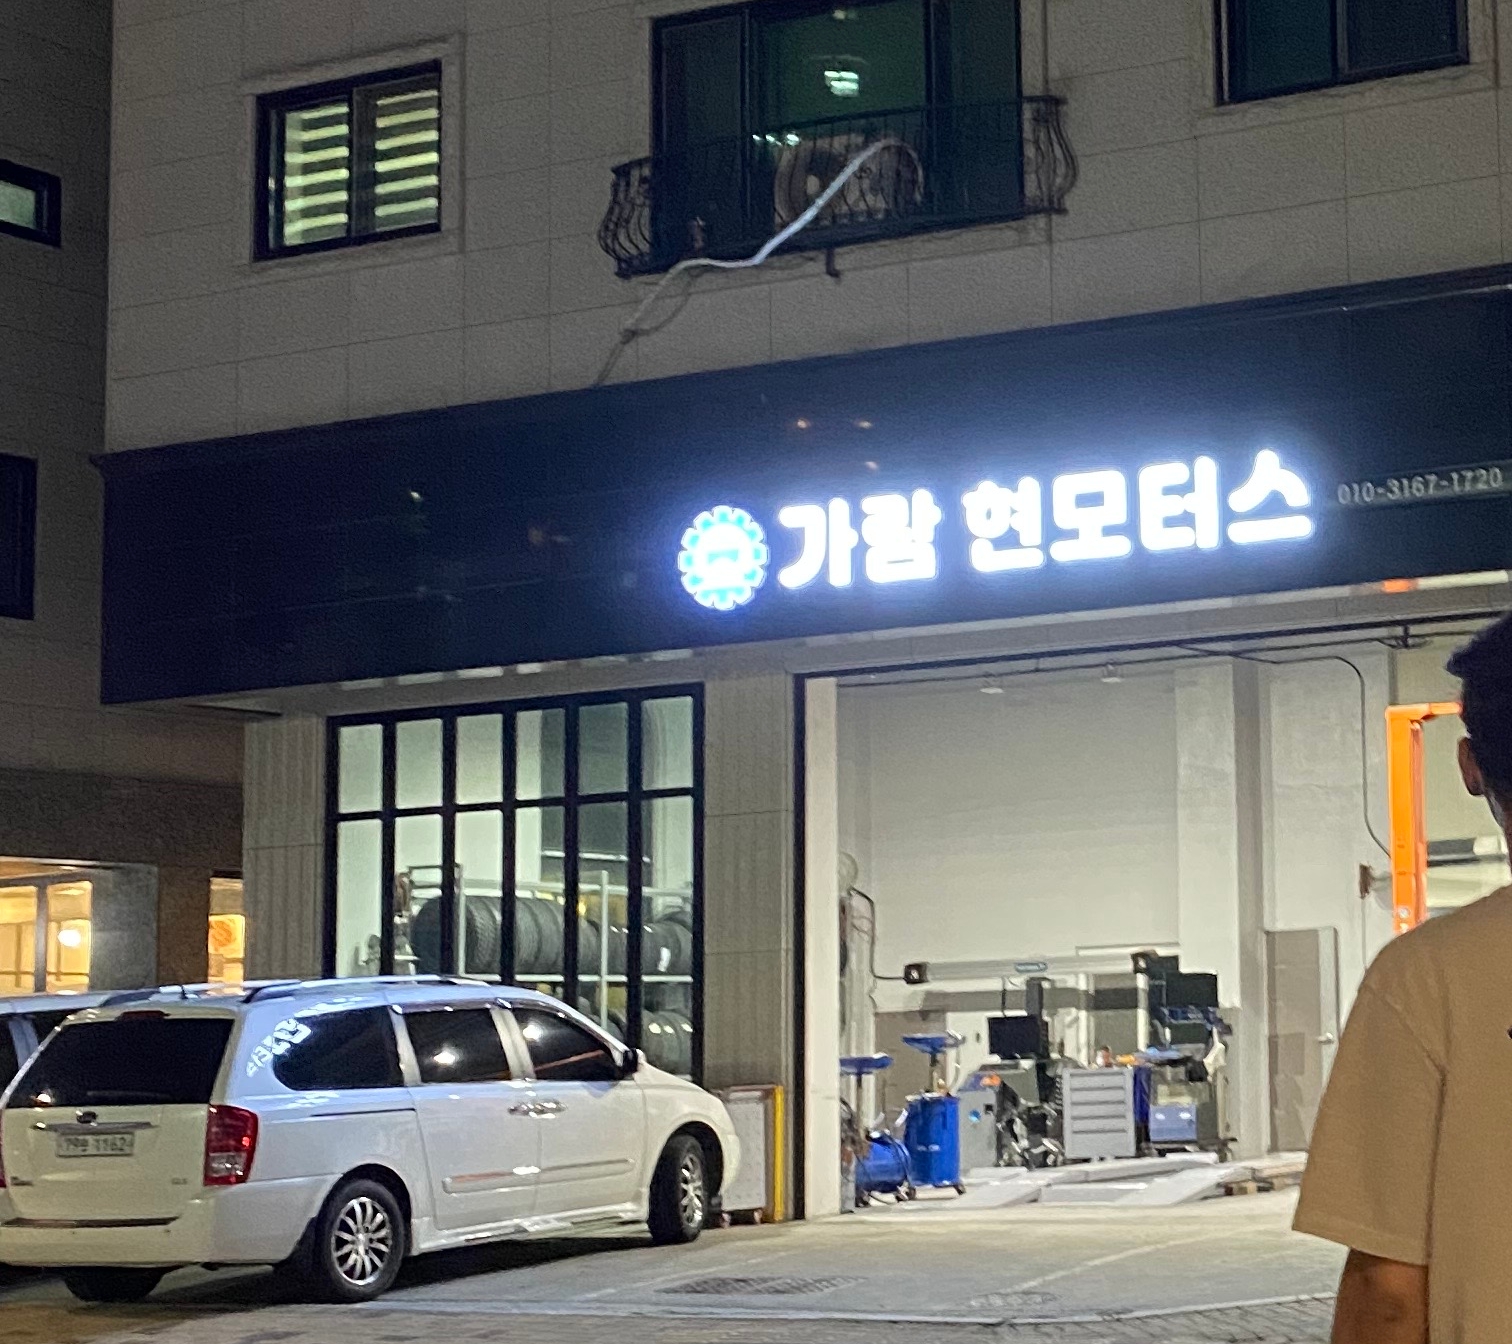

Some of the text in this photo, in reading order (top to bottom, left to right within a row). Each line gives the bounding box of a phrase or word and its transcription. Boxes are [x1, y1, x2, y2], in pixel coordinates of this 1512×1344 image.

[777, 449, 1314, 588] 가람 현모터스
[1337, 466, 1502, 504] 010-3167-1720
